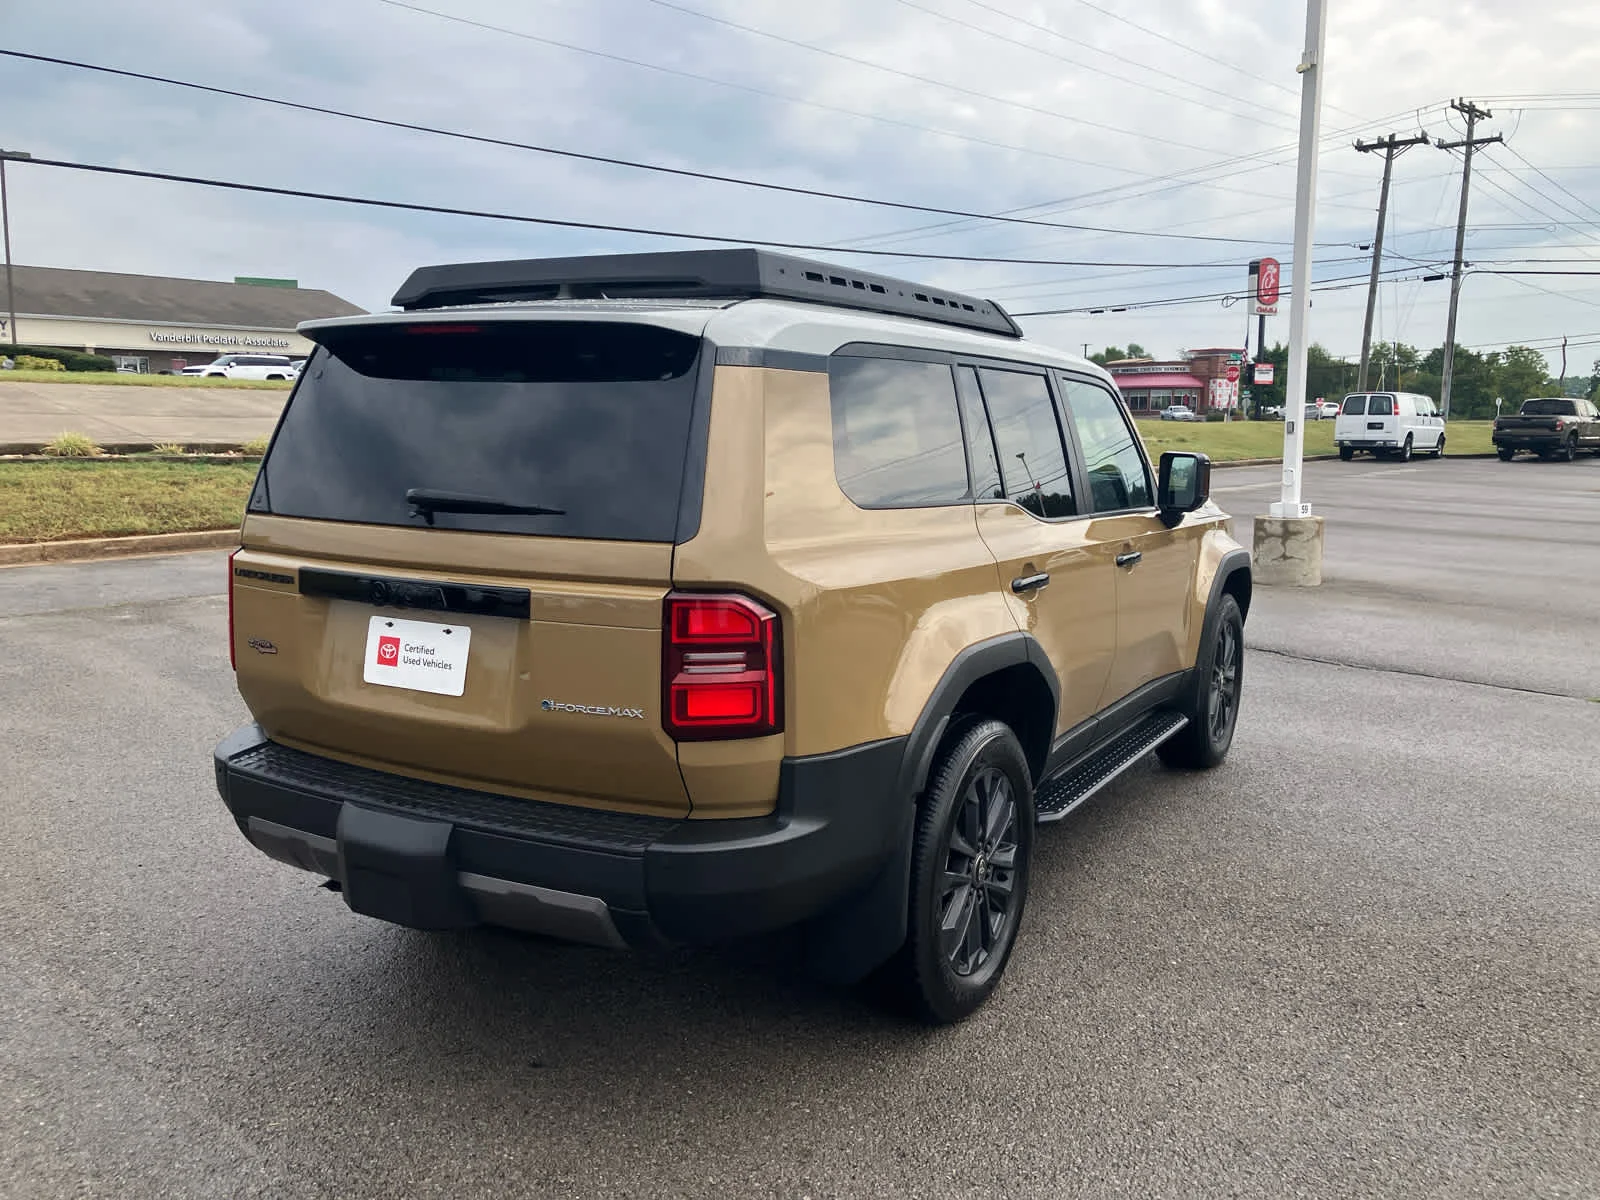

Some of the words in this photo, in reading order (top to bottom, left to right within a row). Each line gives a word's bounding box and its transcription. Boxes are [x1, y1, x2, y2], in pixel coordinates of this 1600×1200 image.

[150, 331, 200, 344] Vanderbilt
[203, 334, 242, 346] Pediatric
[1226, 370, 1240, 379] STOP
[404, 643, 435, 656] Certified
[403, 656, 421, 666] Used
[422, 658, 452, 670] Vehicles
